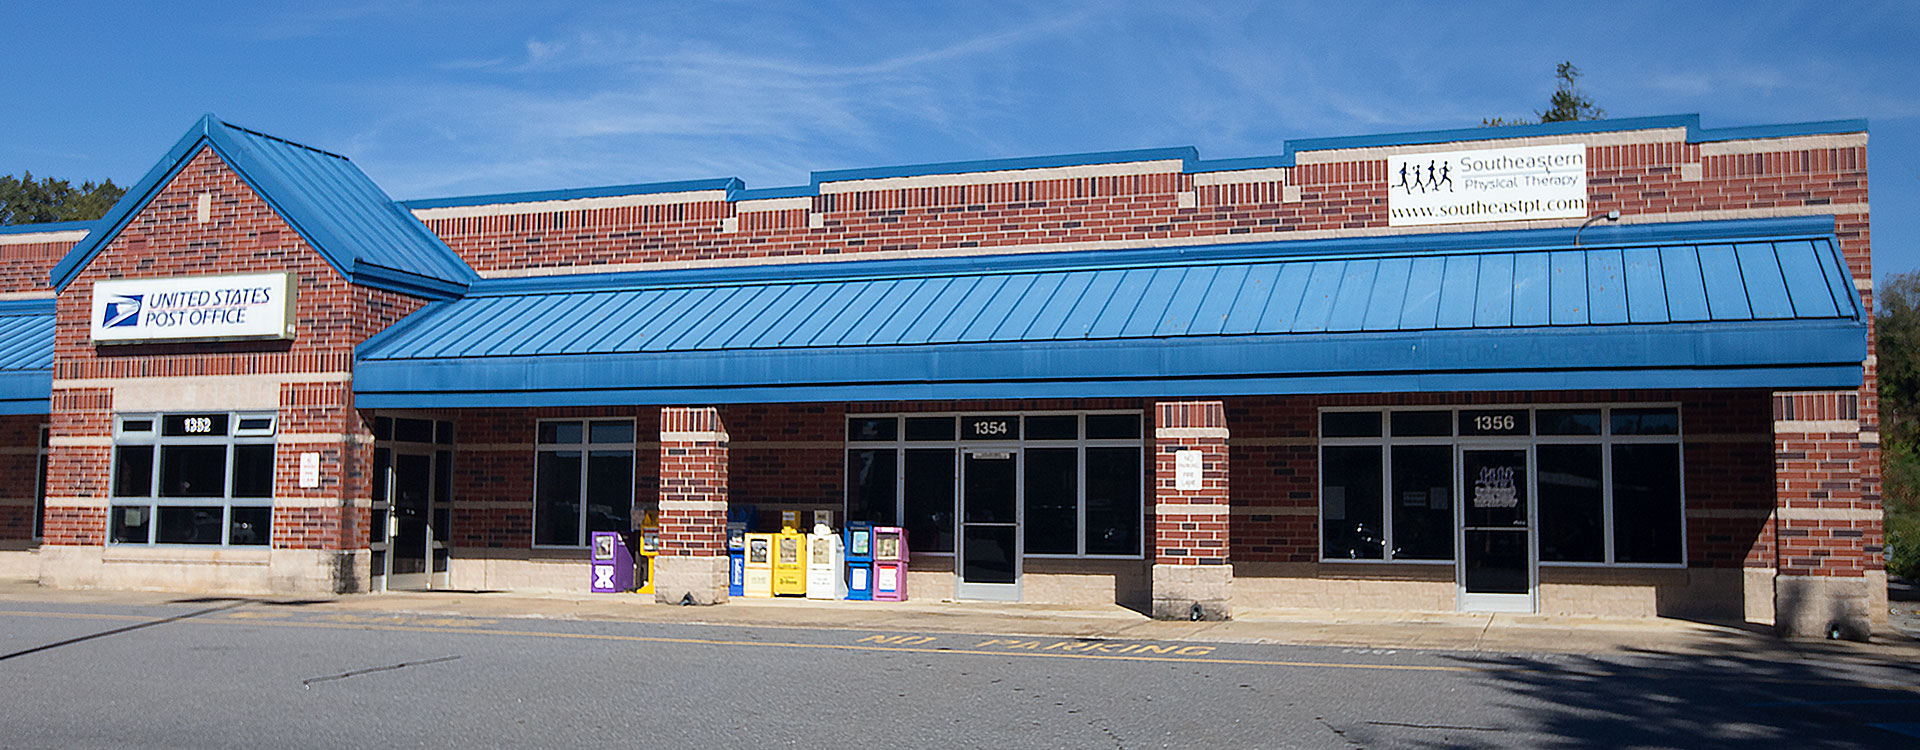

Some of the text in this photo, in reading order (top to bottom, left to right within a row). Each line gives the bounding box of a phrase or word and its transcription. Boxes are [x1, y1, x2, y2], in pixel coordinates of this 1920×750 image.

[1461, 153, 1583, 171] Southeastern
[1464, 174, 1579, 192] Physical Therapy
[1391, 198, 1585, 218] www.southeastpt.com
[149, 286, 272, 308] UNITED STATES
[145, 307, 248, 328] POST OFFICE
[183, 417, 212, 433] 1352
[973, 421, 1008, 435] 1354
[1474, 414, 1515, 430] 1356
[857, 634, 938, 646] NO
[975, 639, 1218, 657] PARKING
